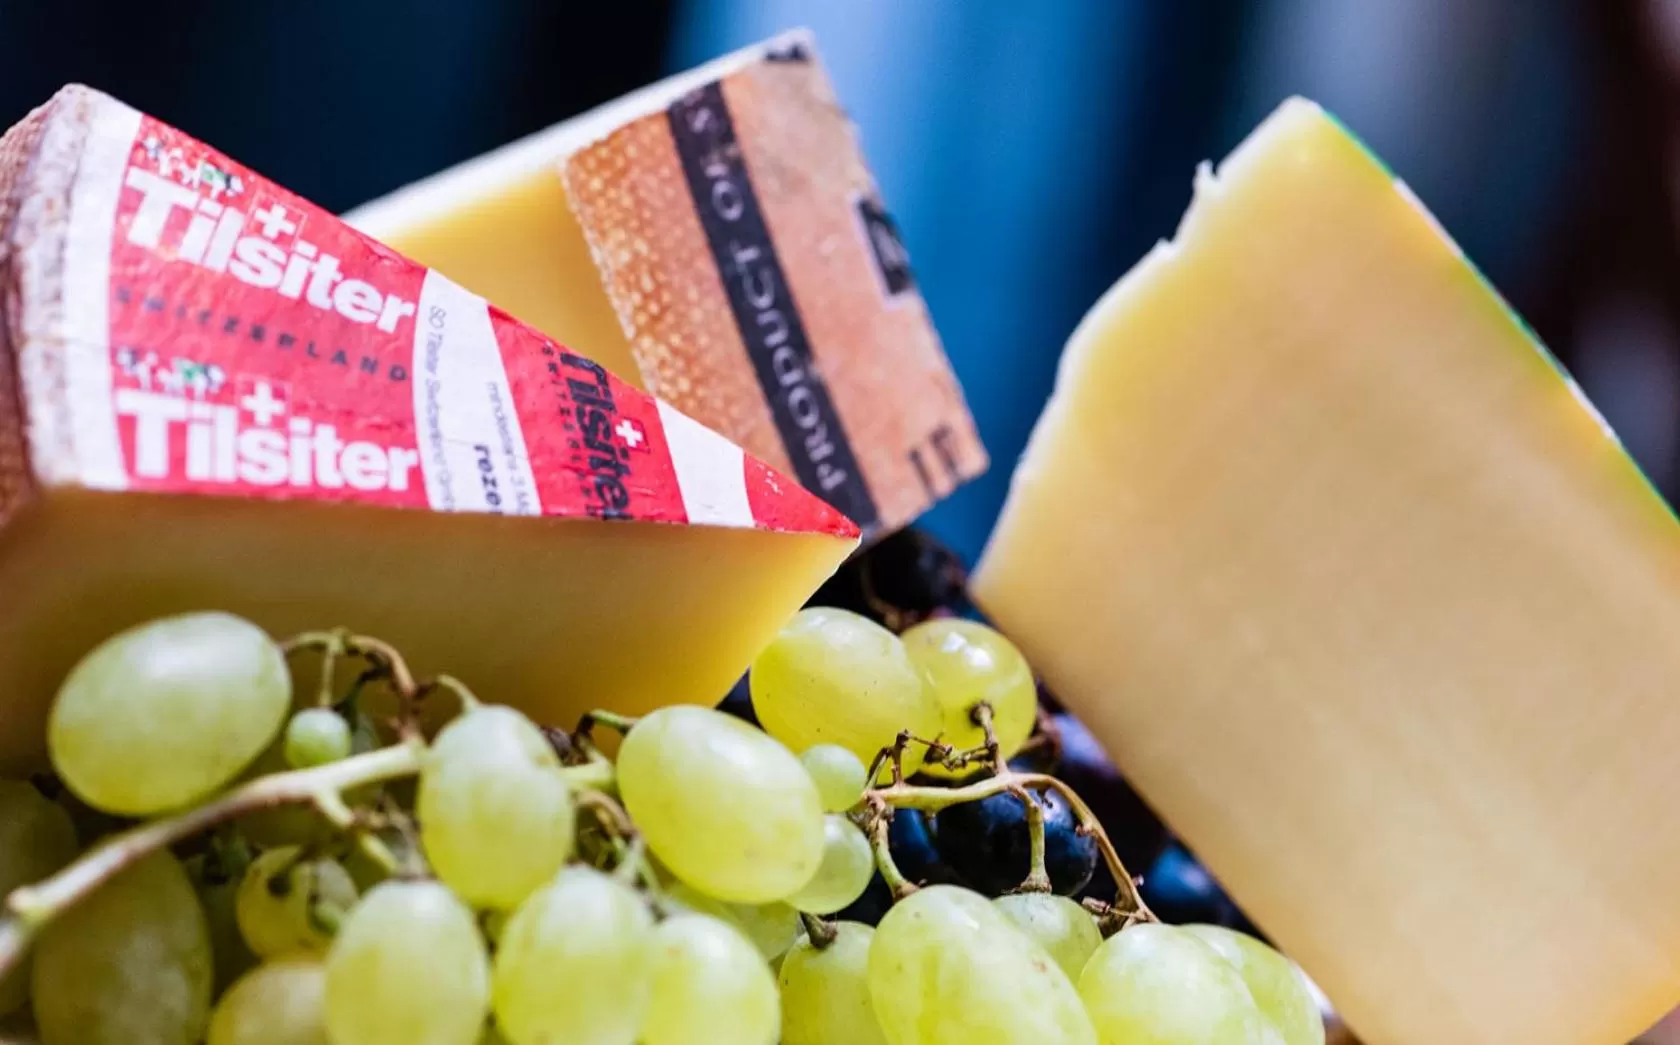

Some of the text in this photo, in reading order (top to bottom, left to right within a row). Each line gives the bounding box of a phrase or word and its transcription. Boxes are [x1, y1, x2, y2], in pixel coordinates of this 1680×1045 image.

[125, 166, 416, 334] Tilsiter
[117, 287, 408, 382] SWITZERLAND
[729, 239, 847, 491] PRODUCT
[115, 388, 420, 491] Tilsiter
[560, 352, 635, 521] Tilsiter
